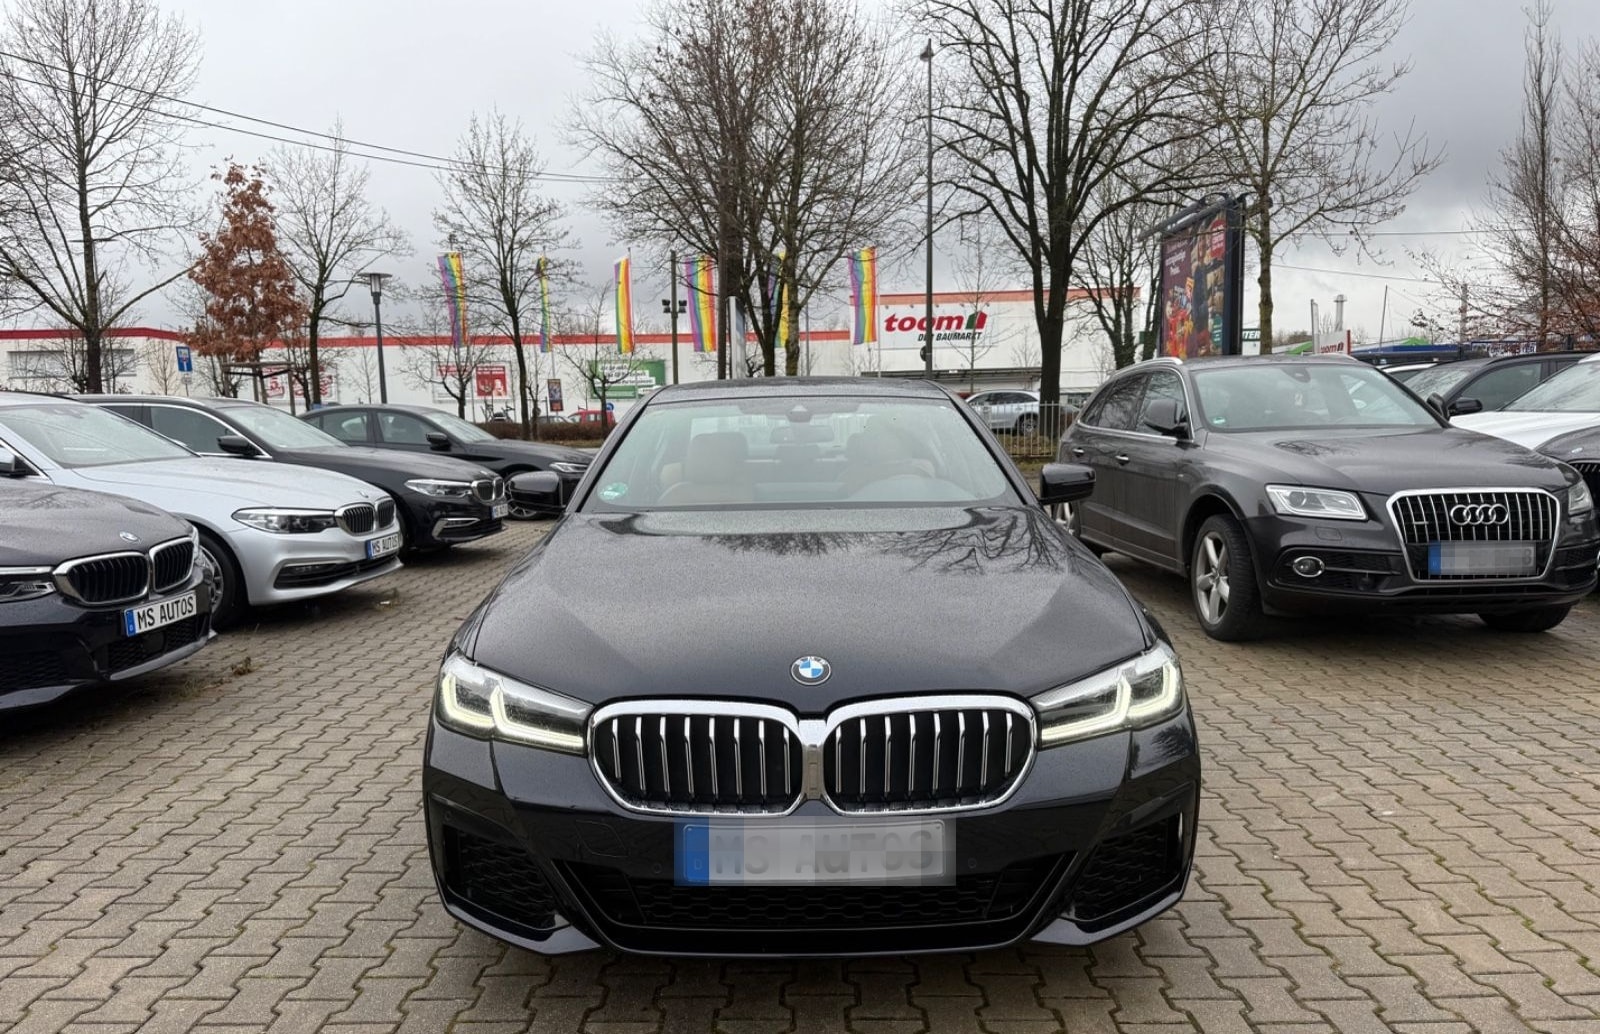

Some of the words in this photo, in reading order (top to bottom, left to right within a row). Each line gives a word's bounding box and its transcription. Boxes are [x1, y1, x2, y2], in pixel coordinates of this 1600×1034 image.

[885, 313, 964, 332] toom
[137, 607, 155, 629] MS
[160, 596, 194, 623] AUTOS
